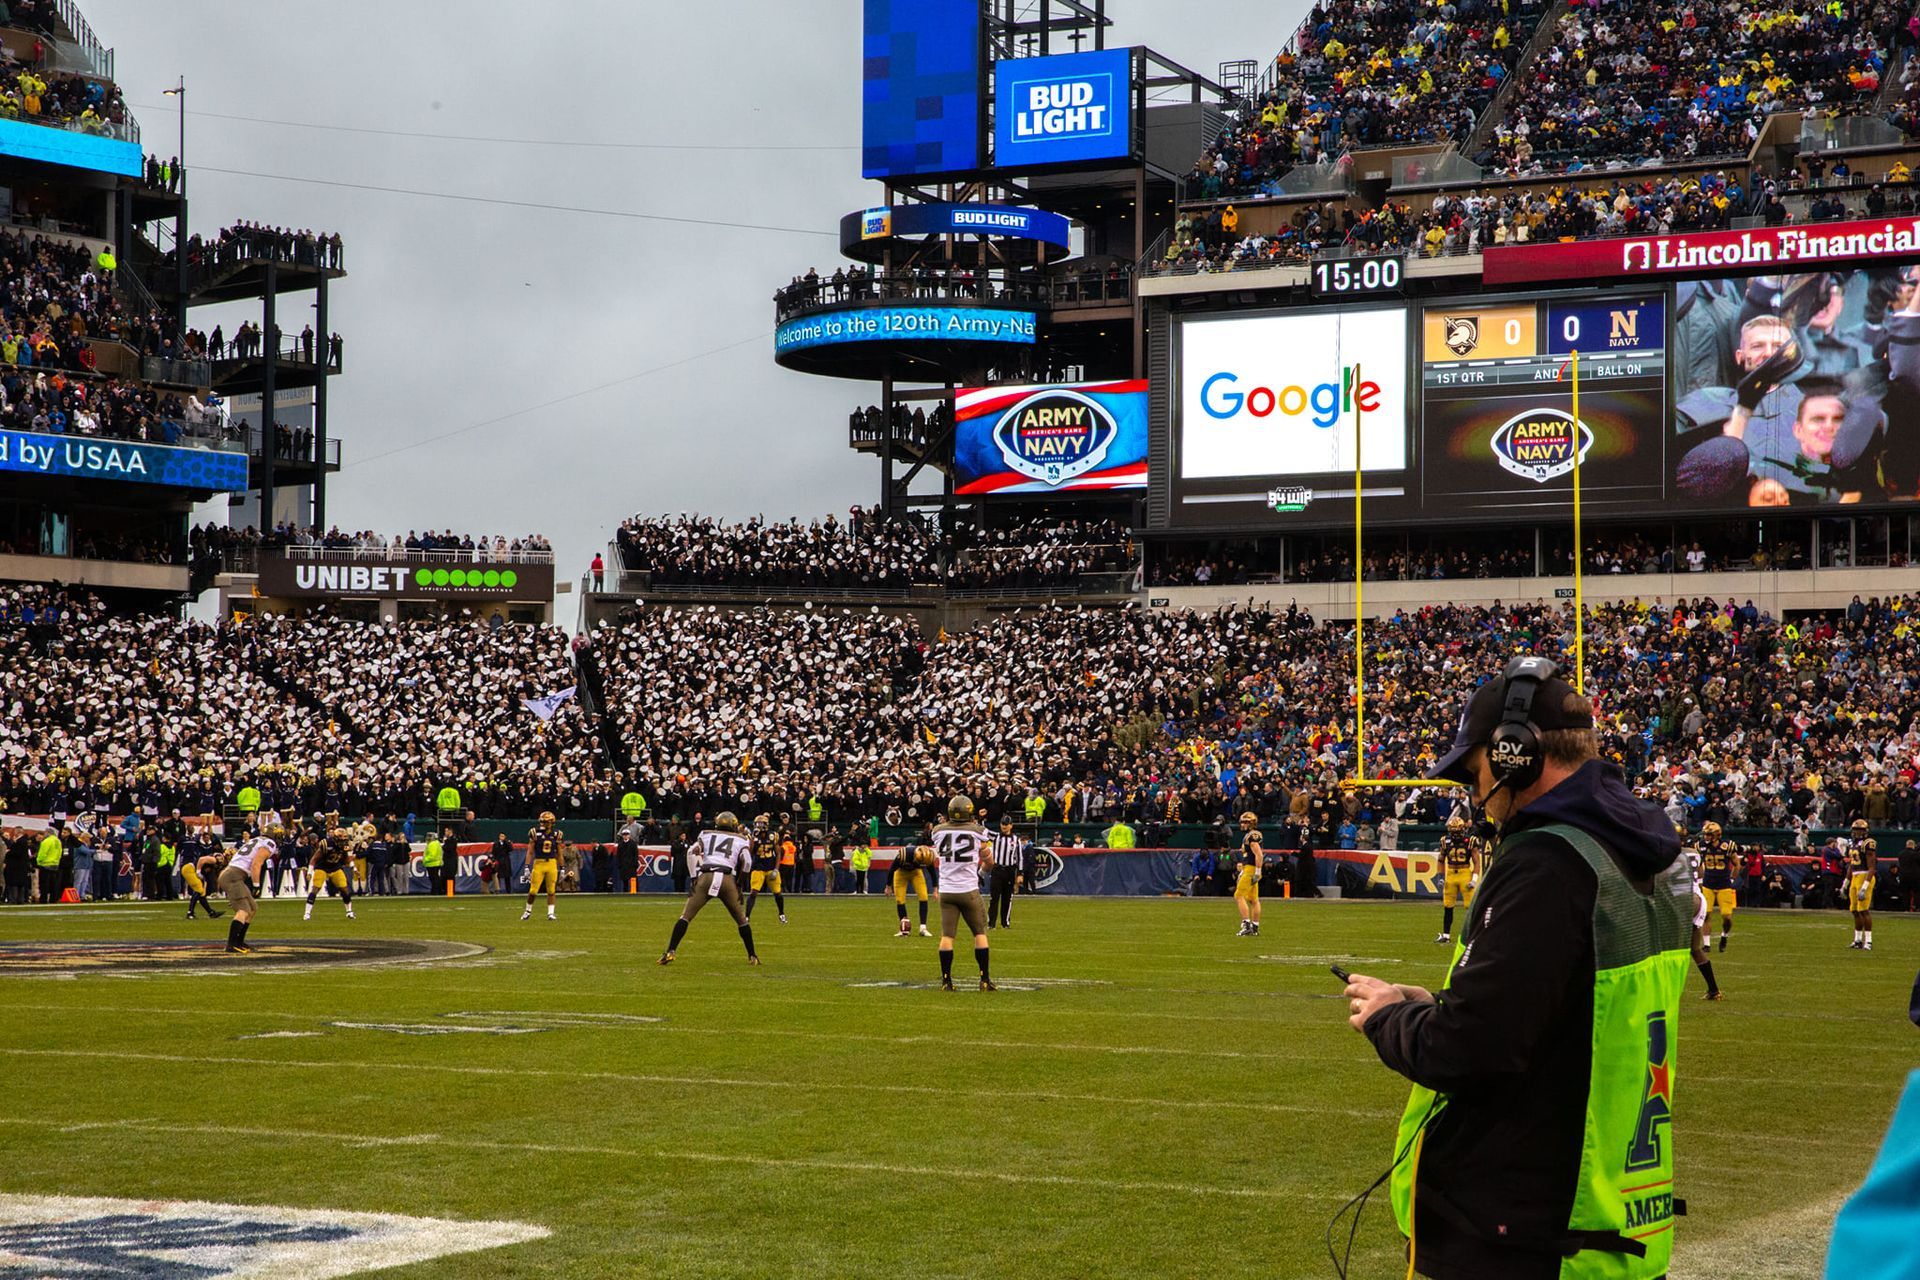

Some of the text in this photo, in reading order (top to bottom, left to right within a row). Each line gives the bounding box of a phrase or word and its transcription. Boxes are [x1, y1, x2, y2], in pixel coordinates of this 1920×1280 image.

[1030, 82, 1093, 110] BUD
[1018, 105, 1106, 136] LIGHT
[865, 225, 887, 234] LIGHT
[867, 218, 883, 227] BUD
[954, 212, 1027, 227] BUD LIGHT
[1656, 221, 1920, 268] Lincoln Financial
[1317, 259, 1399, 292] 15:00
[826, 322, 842, 335] to
[848, 318, 877, 332] the
[884, 315, 939, 331] 120th
[949, 316, 1036, 335] Army-Na
[1505, 319, 1521, 346] 0
[1563, 315, 1580, 342] 0
[1609, 309, 1639, 338] N
[1609, 337, 1640, 347] NAVY
[1436, 371, 1485, 384] 1ST QTR
[1534, 369, 1559, 380] AND
[1597, 364, 1642, 376] BALL ON
[1200, 367, 1381, 428] Google
[1022, 406, 1087, 428] ARMY
[1514, 421, 1568, 438] ARMY
[20, 437, 54, 470] by
[65, 442, 147, 474] USAA
[1025, 436, 1086, 456] NAVY
[1516, 444, 1568, 460] NAVY
[296, 565, 410, 591] UNIBET
[1491, 748, 1533, 767] SPORT
[1499, 741, 1523, 755] DV
[708, 834, 735, 859] 14
[938, 833, 975, 863] 42
